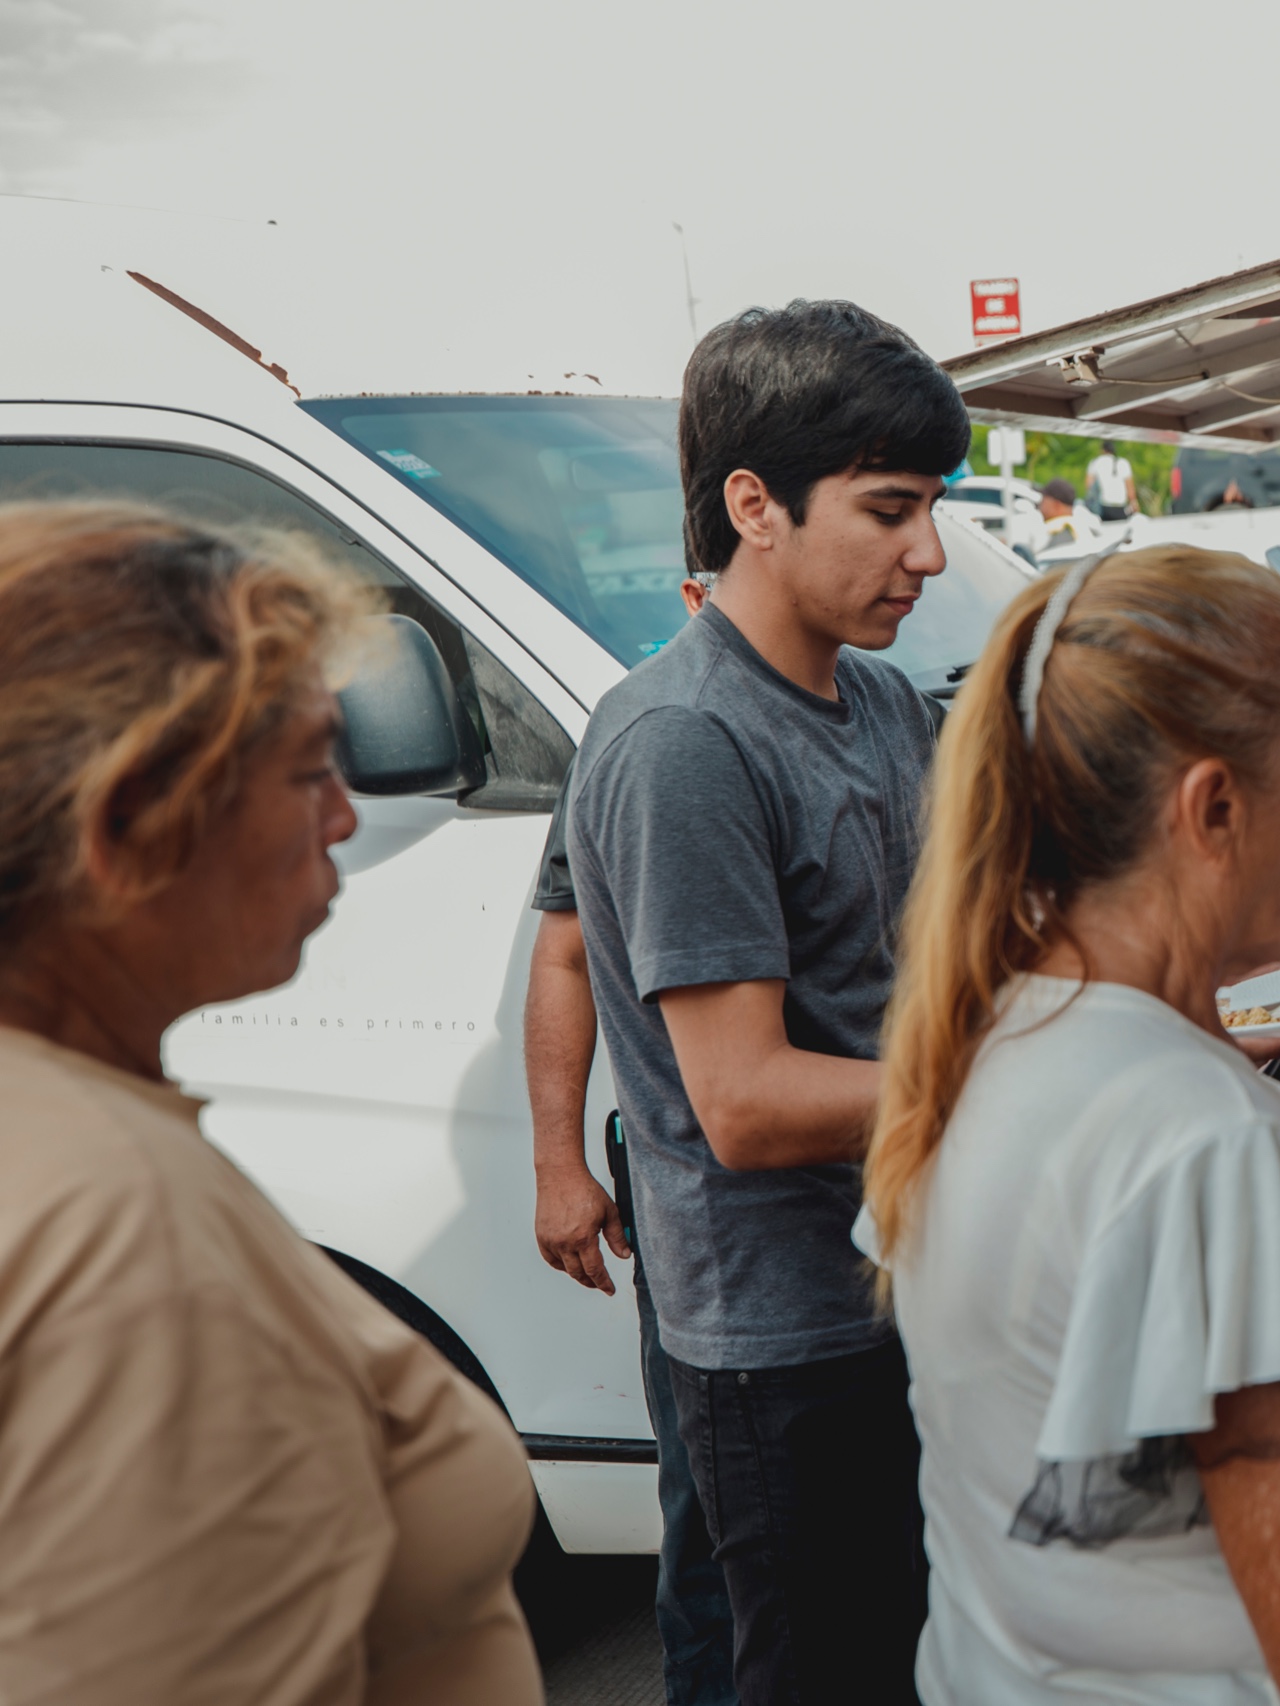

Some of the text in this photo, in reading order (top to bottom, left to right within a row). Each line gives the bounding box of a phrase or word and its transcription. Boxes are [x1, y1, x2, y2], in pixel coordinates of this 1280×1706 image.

[200, 1011, 476, 1032] familia es primero
